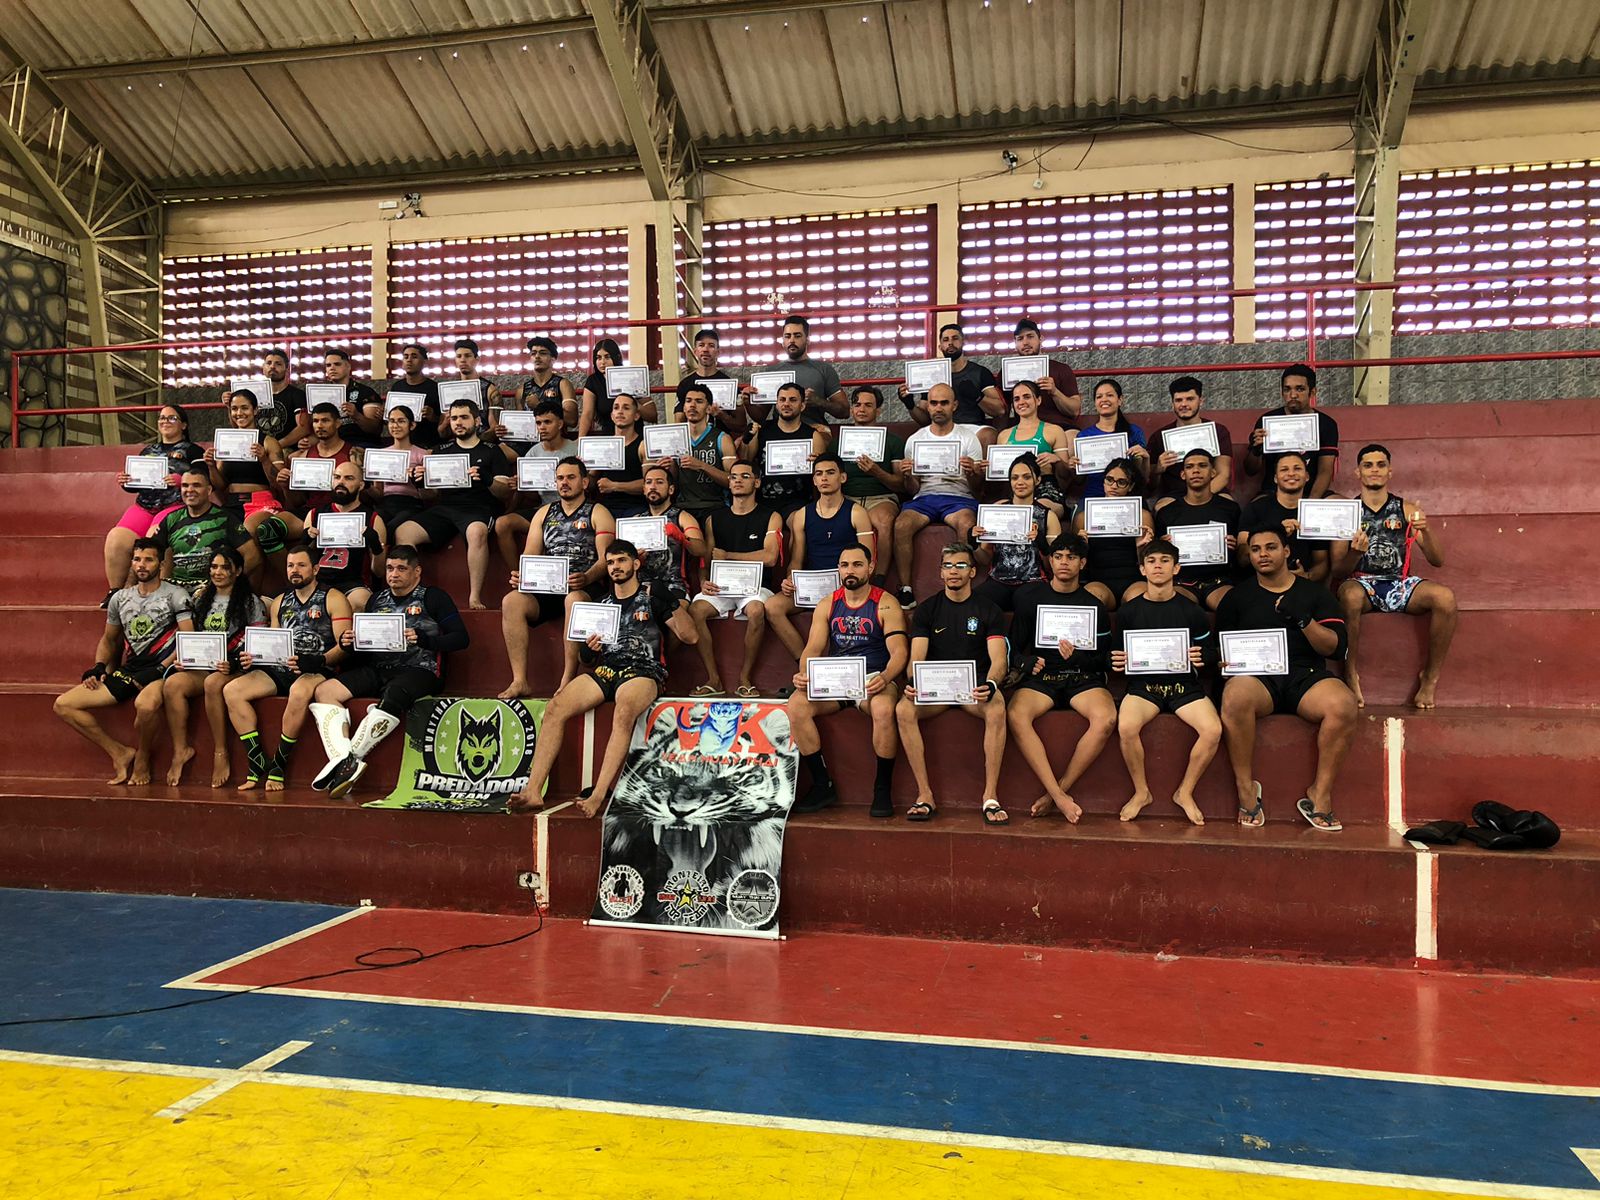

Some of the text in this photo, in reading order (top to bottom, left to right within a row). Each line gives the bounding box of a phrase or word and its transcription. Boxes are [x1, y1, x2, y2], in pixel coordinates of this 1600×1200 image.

[319, 547, 349, 569] 23
[525, 726, 534, 755] 2018
[701, 754, 741, 765] MUAY
[746, 757, 779, 767] THAI
[417, 772, 529, 793] PREDADOR
[449, 791, 491, 800] TEAM
[665, 871, 710, 893] MONTEIRO
